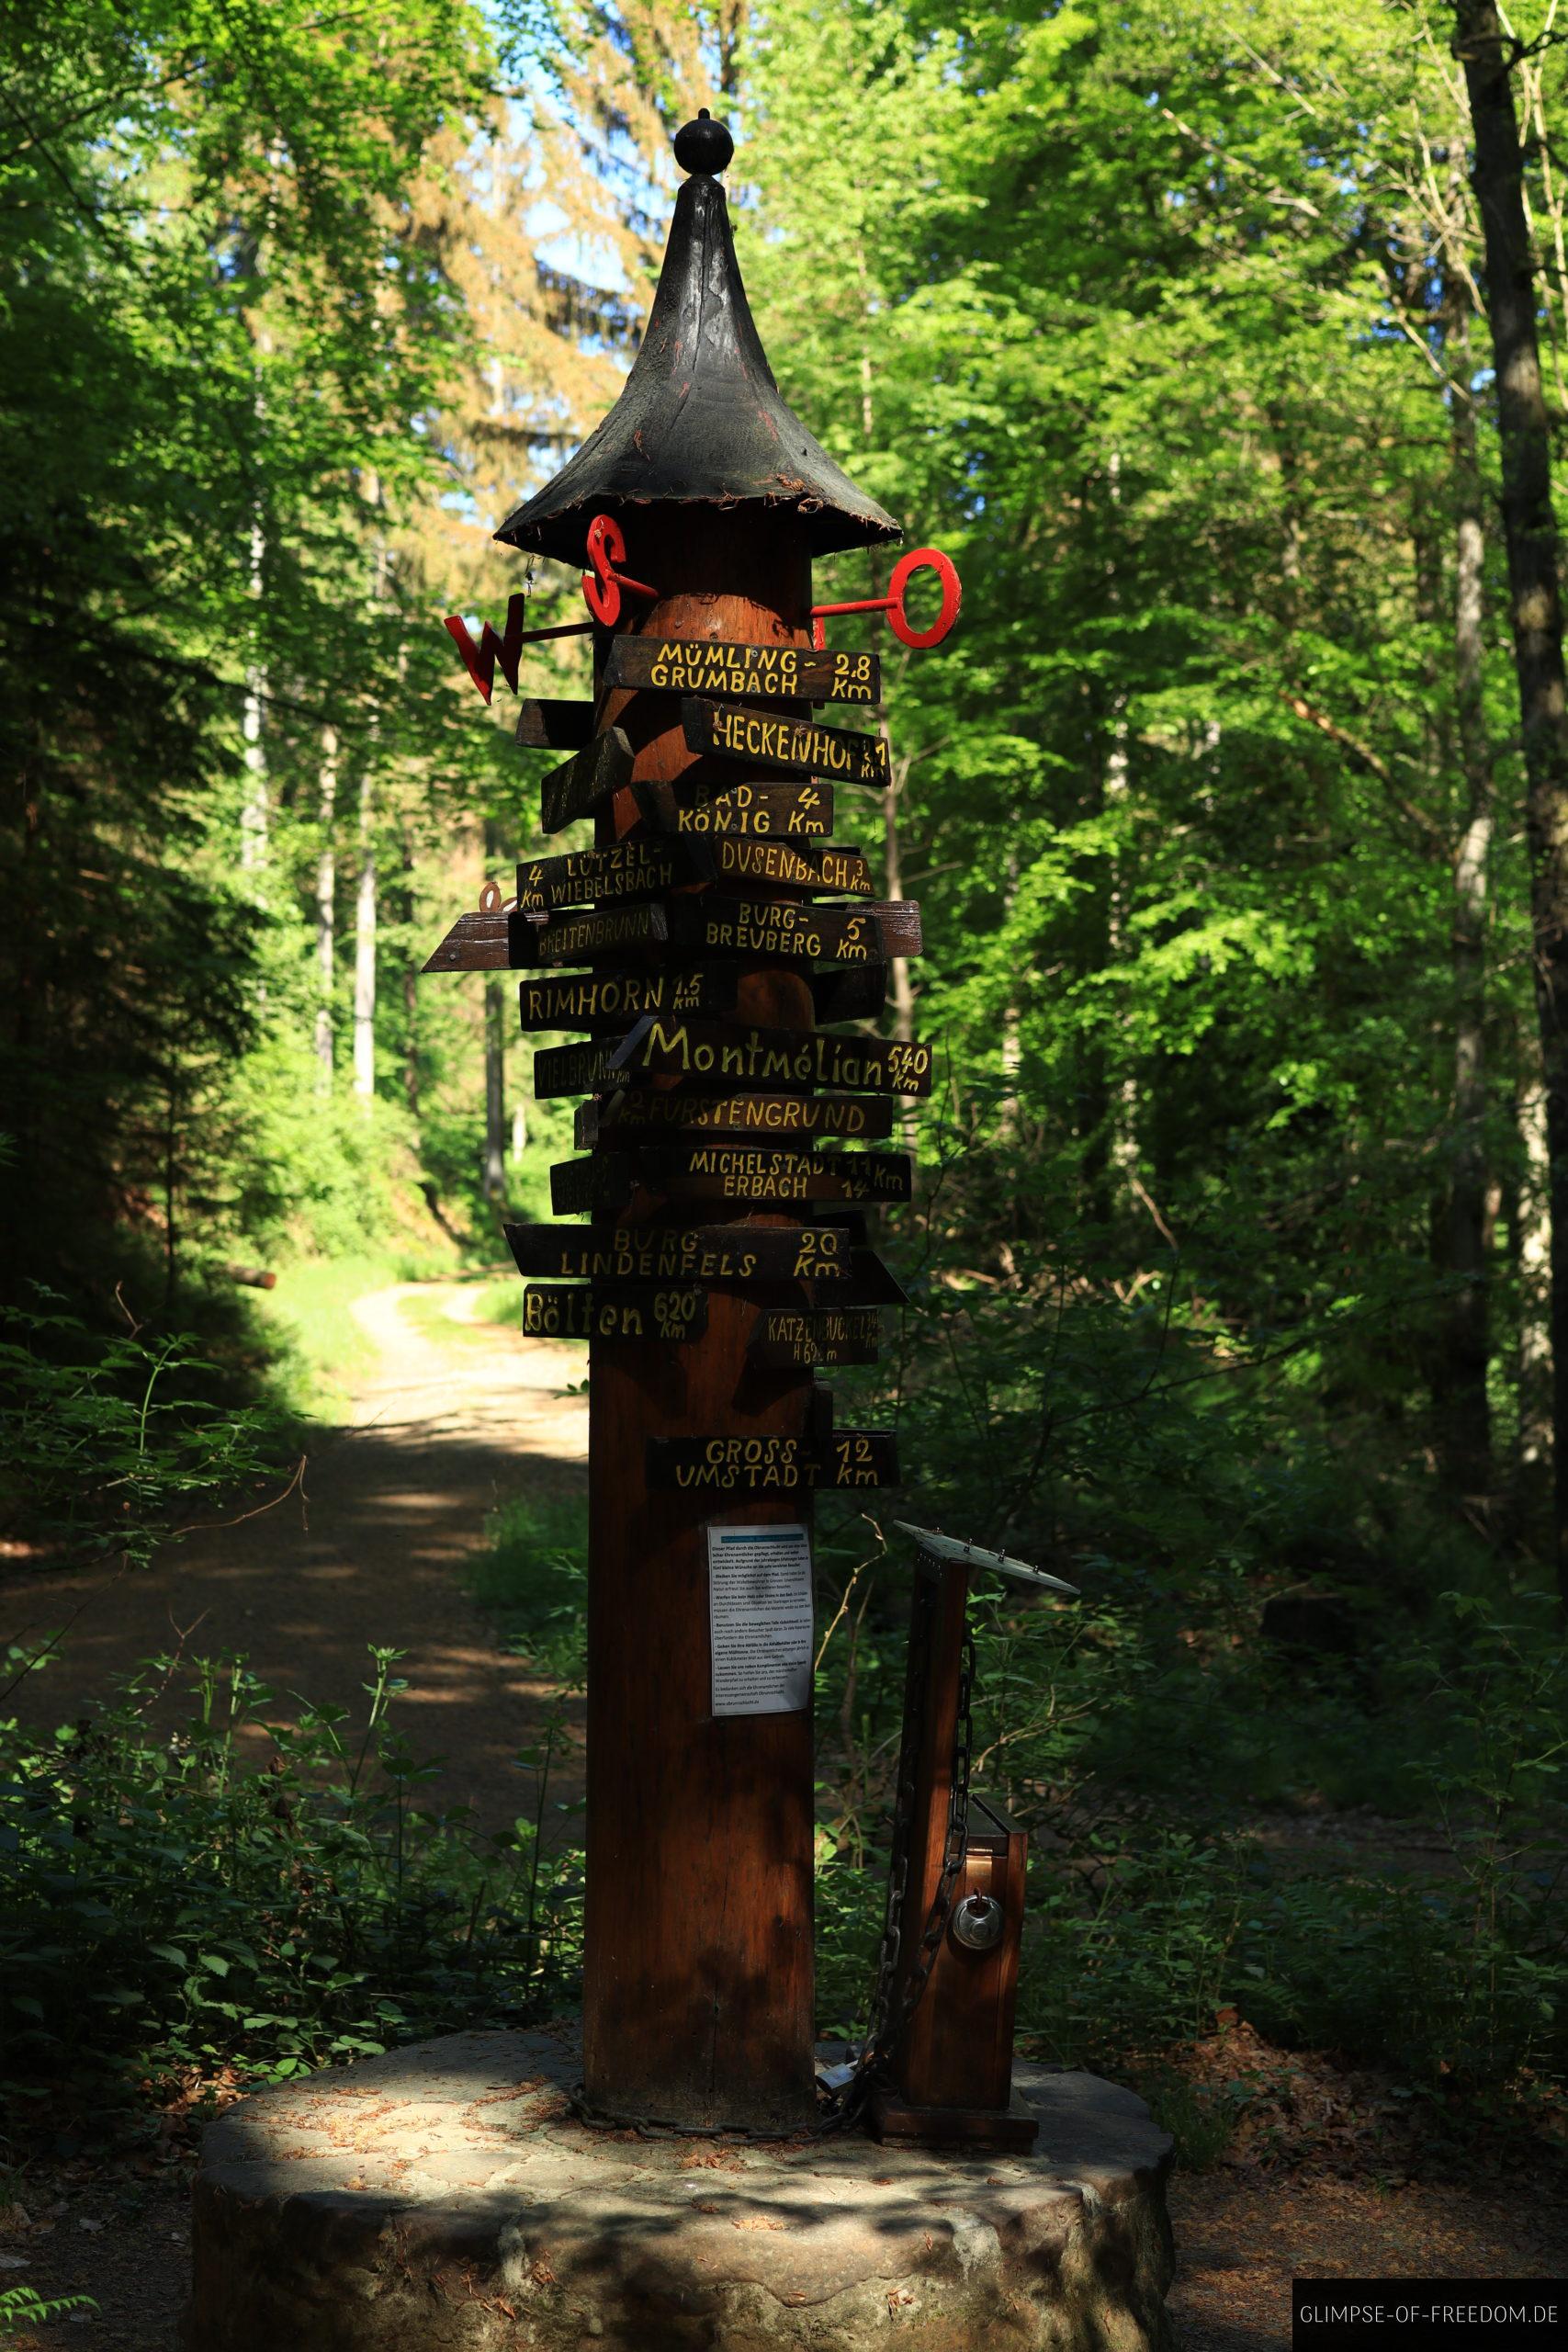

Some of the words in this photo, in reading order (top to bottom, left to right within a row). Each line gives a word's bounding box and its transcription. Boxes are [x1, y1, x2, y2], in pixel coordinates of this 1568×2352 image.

[581, 514, 626, 627] S
[887, 548, 962, 650] O
[444, 593, 525, 707] W
[650, 664, 797, 695] GRUMBACH
[834, 653, 871, 681] 2.8
[797, 787, 820, 809] 4
[678, 807, 770, 833] KÖNIG
[528, 865, 544, 887] 4
[855, 859, 864, 876] 3
[550, 862, 673, 904] WIEBELSBACH
[847, 917, 866, 940] 5
[529, 976, 665, 1021] RIMHORN
[642, 1020, 883, 1086] Montmélian
[887, 1045, 929, 1075] 540
[688, 1151, 838, 1177] MICHELSTADT
[723, 1174, 807, 1198] ERBACH
[614, 1228, 698, 1252] BURG
[799, 1231, 837, 1255] 20
[560, 1250, 757, 1277] LINDENFELS
[526, 1292, 642, 1336] Bölten
[653, 1291, 696, 1322] 620
[836, 1440, 873, 1463] 12
[676, 1464, 821, 1488] UMSTADT
